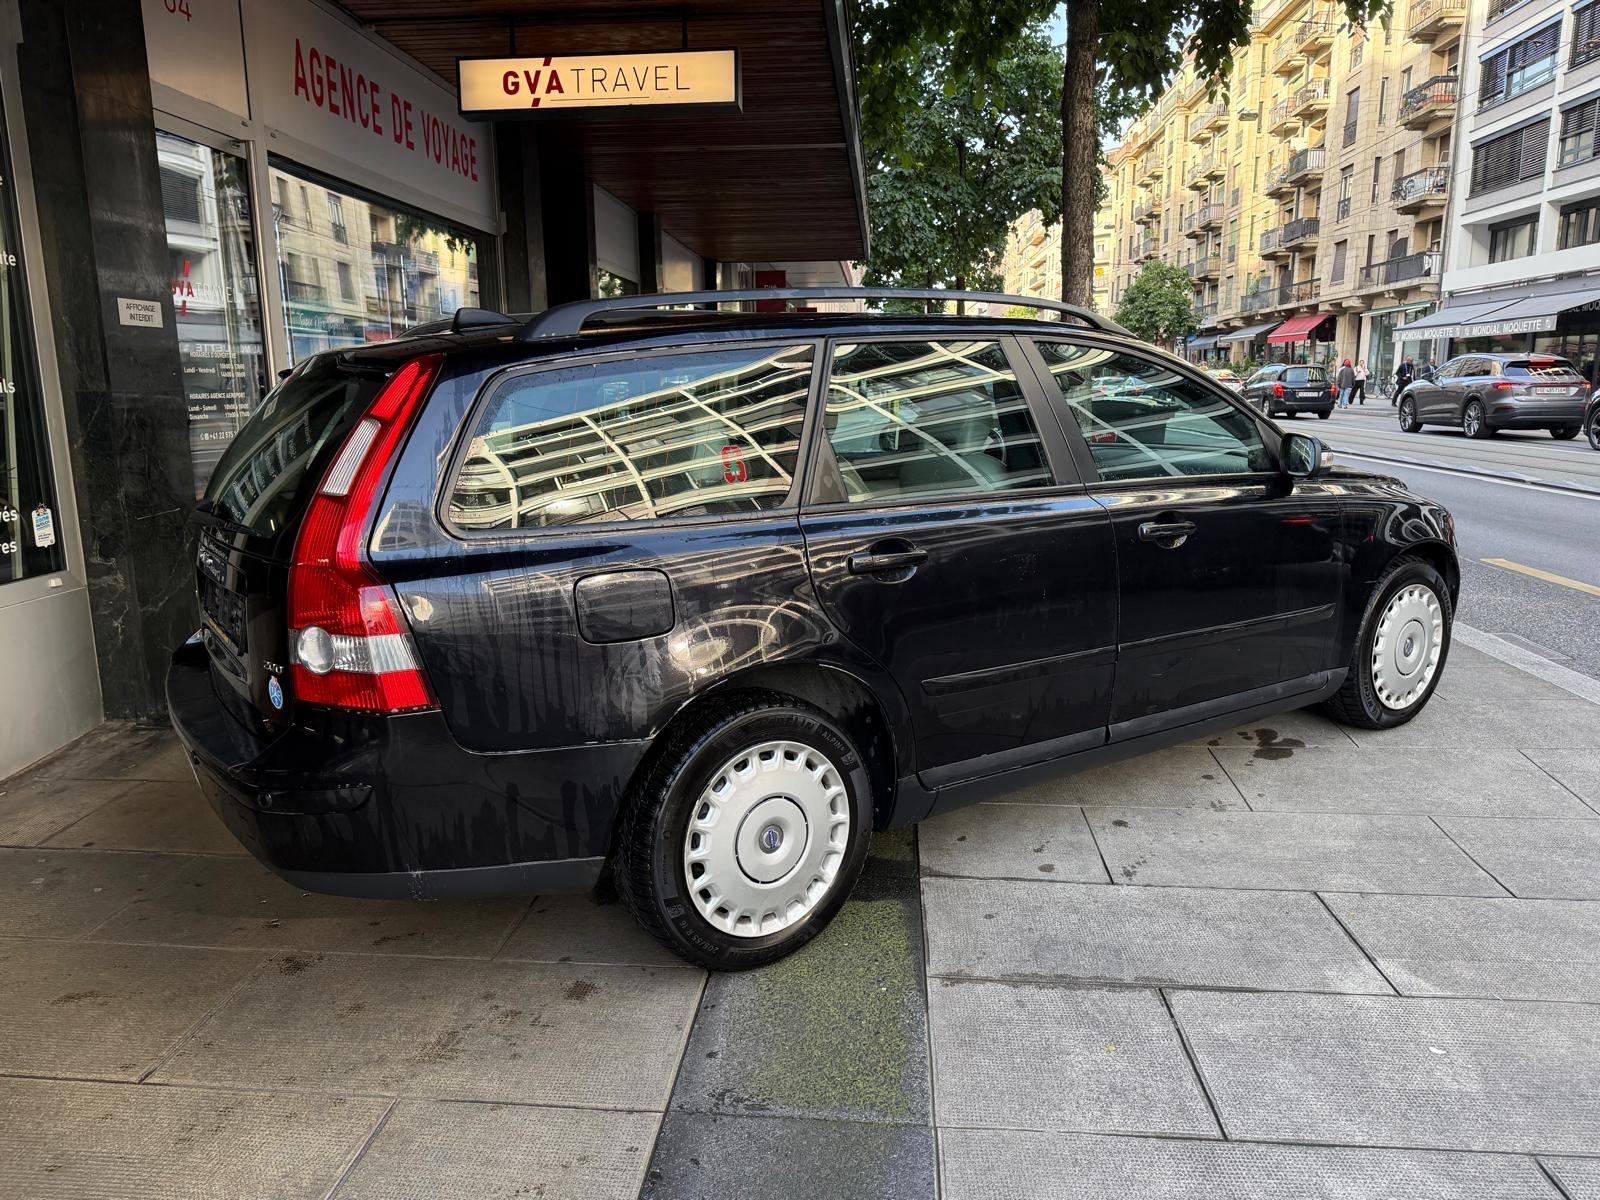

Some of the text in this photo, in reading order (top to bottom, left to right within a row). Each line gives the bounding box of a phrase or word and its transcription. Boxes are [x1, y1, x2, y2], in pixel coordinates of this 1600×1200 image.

[502, 65, 690, 96] GVA TRAVEL
[294, 38, 478, 182] AGENCE DE VOYAGE
[126, 303, 156, 313] AFFICHAGE
[129, 313, 154, 322] INTERDIT
[1402, 327, 1453, 341] MONDIAL MOQUETTE
[1472, 319, 1541, 337] MONDIAL MOQUETTE
